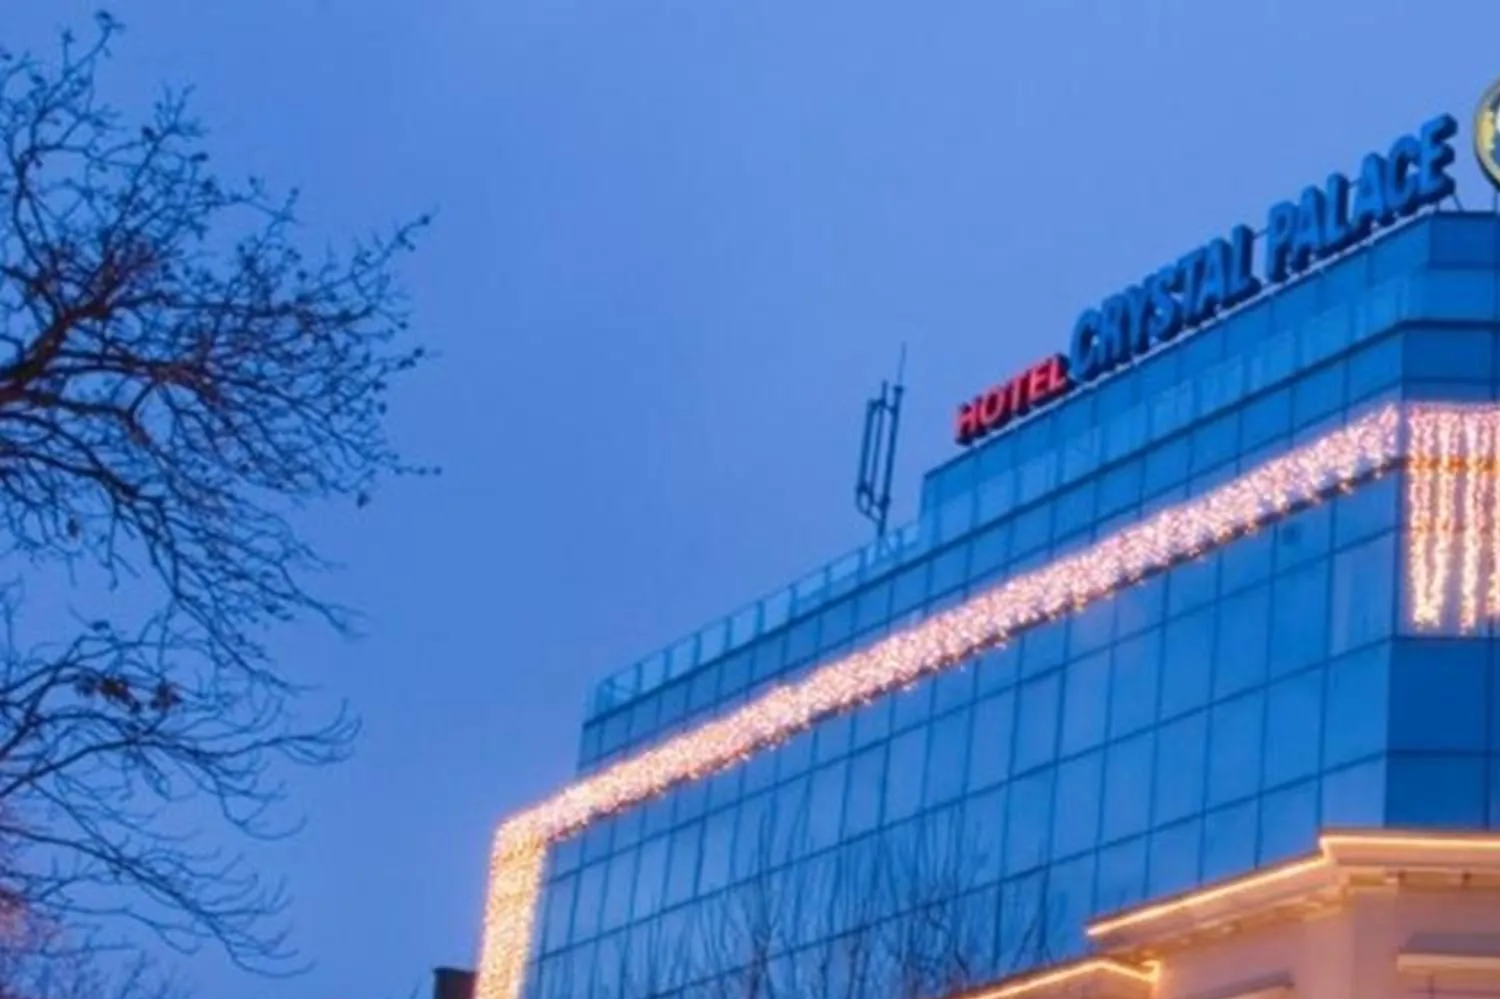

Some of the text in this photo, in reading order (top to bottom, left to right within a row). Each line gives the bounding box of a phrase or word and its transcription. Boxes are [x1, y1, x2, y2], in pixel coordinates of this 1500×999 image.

[954, 112, 1459, 445] HOTEL CRYSTAL PALACE
